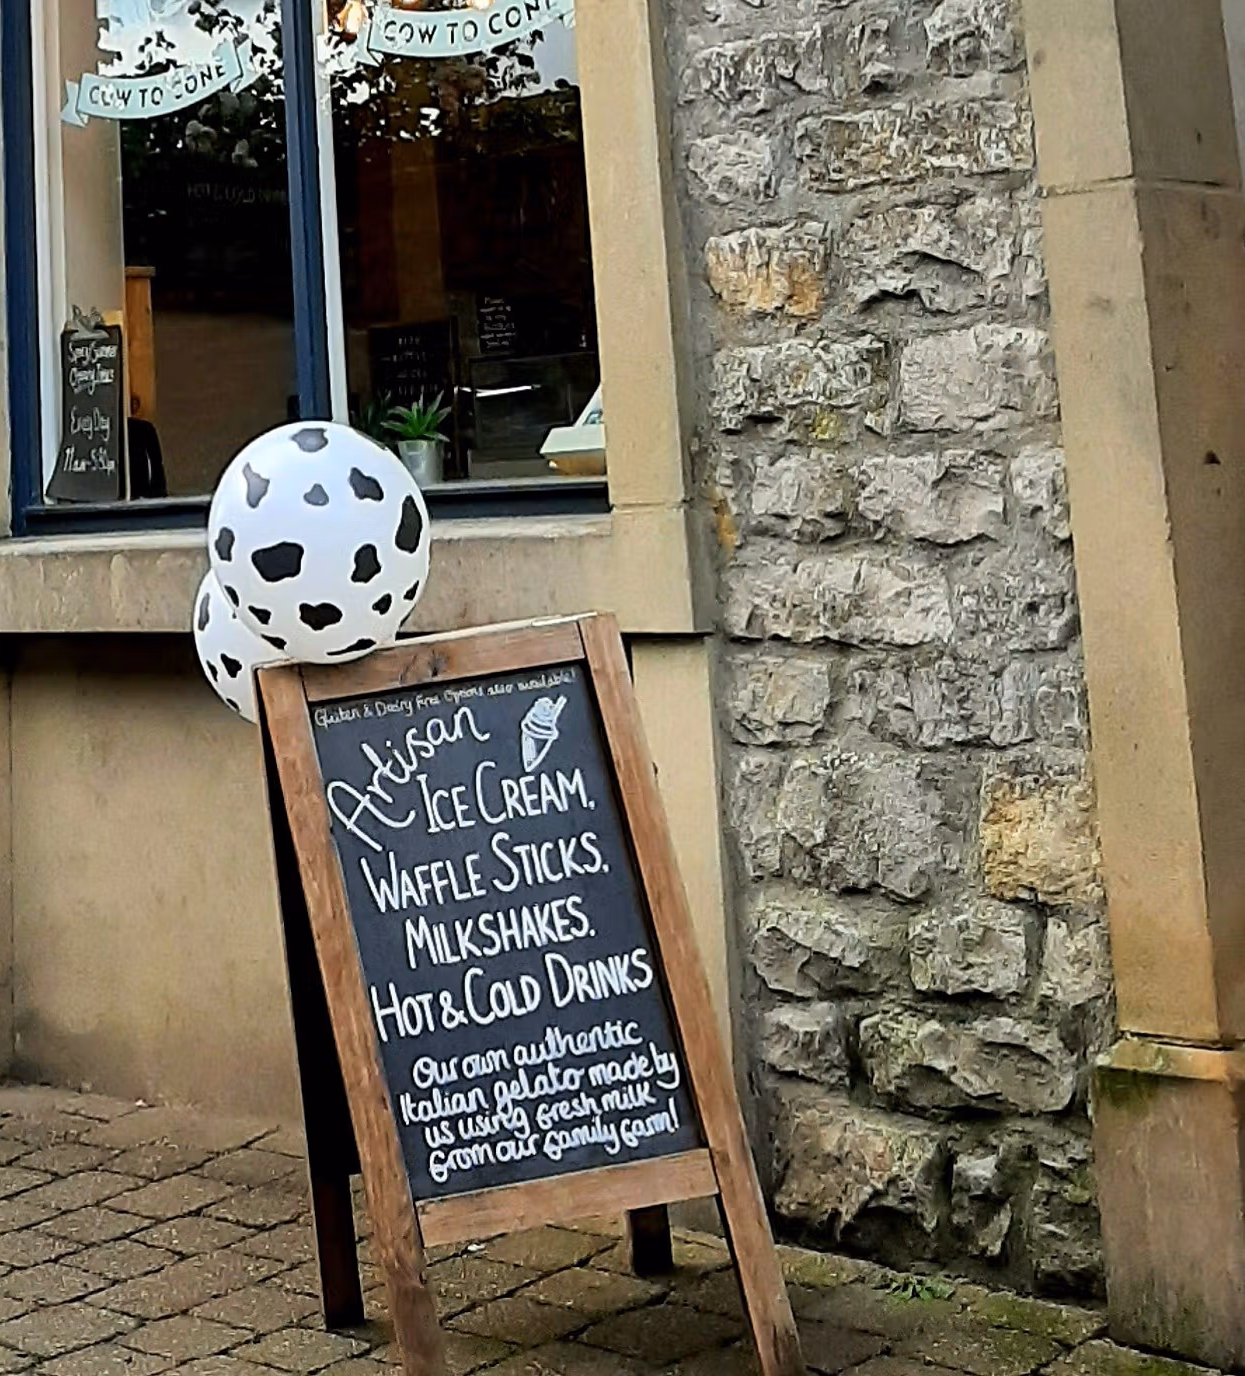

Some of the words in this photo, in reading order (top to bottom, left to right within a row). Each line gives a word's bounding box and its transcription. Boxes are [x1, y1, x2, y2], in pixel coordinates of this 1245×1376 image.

[384, 20, 437, 44] COW
[446, 20, 478, 44] TO
[139, 86, 163, 108] TO
[314, 707, 361, 728] Gluten
[375, 698, 413, 718] Dairy
[327, 706, 490, 852] Artisan
[416, 773, 476, 833] ICE
[360, 851, 487, 913] WAFFLE
[371, 982, 434, 1042] HOT
[464, 967, 542, 1025] COLD
[544, 948, 654, 1008] DRINKS
[400, 1087, 489, 1125] Italian
[493, 1063, 585, 1120] gelato
[589, 1052, 653, 1088] made
[649, 1043, 681, 1089] by
[412, 1057, 458, 1089] Our
[462, 1048, 511, 1079] own
[514, 1021, 643, 1067] authentic
[425, 1120, 455, 1148] us
[458, 1106, 531, 1140] using
[535, 1091, 601, 1130] fresh
[604, 1081, 656, 1113] milk
[428, 1145, 495, 1184] from
[496, 1132, 543, 1162] our
[543, 1116, 621, 1161] family
[620, 1097, 680, 1148] farm!
